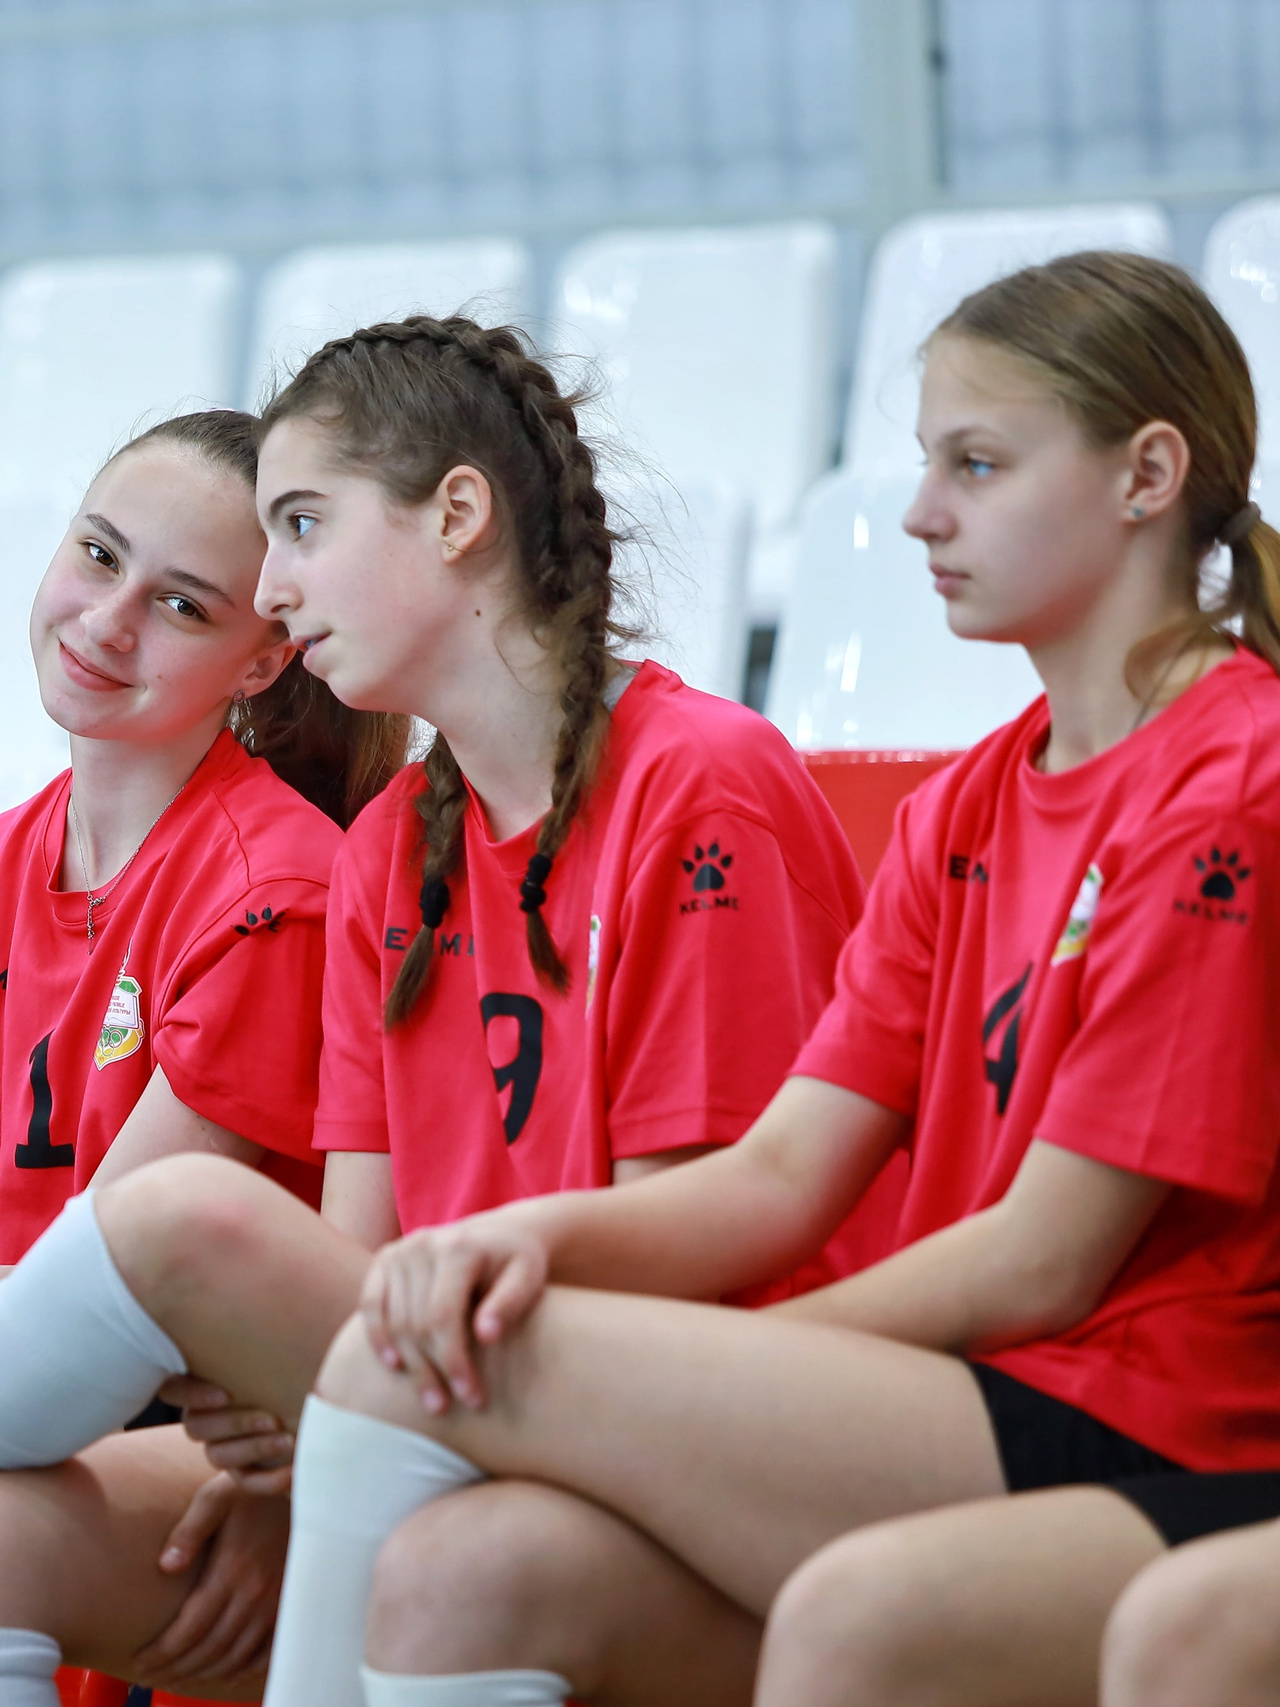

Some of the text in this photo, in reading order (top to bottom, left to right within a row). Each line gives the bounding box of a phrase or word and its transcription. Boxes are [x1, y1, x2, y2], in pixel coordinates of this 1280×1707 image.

[679, 896, 740, 916] KELME
[14, 1029, 75, 1169] 1
[480, 991, 543, 1145] 9
